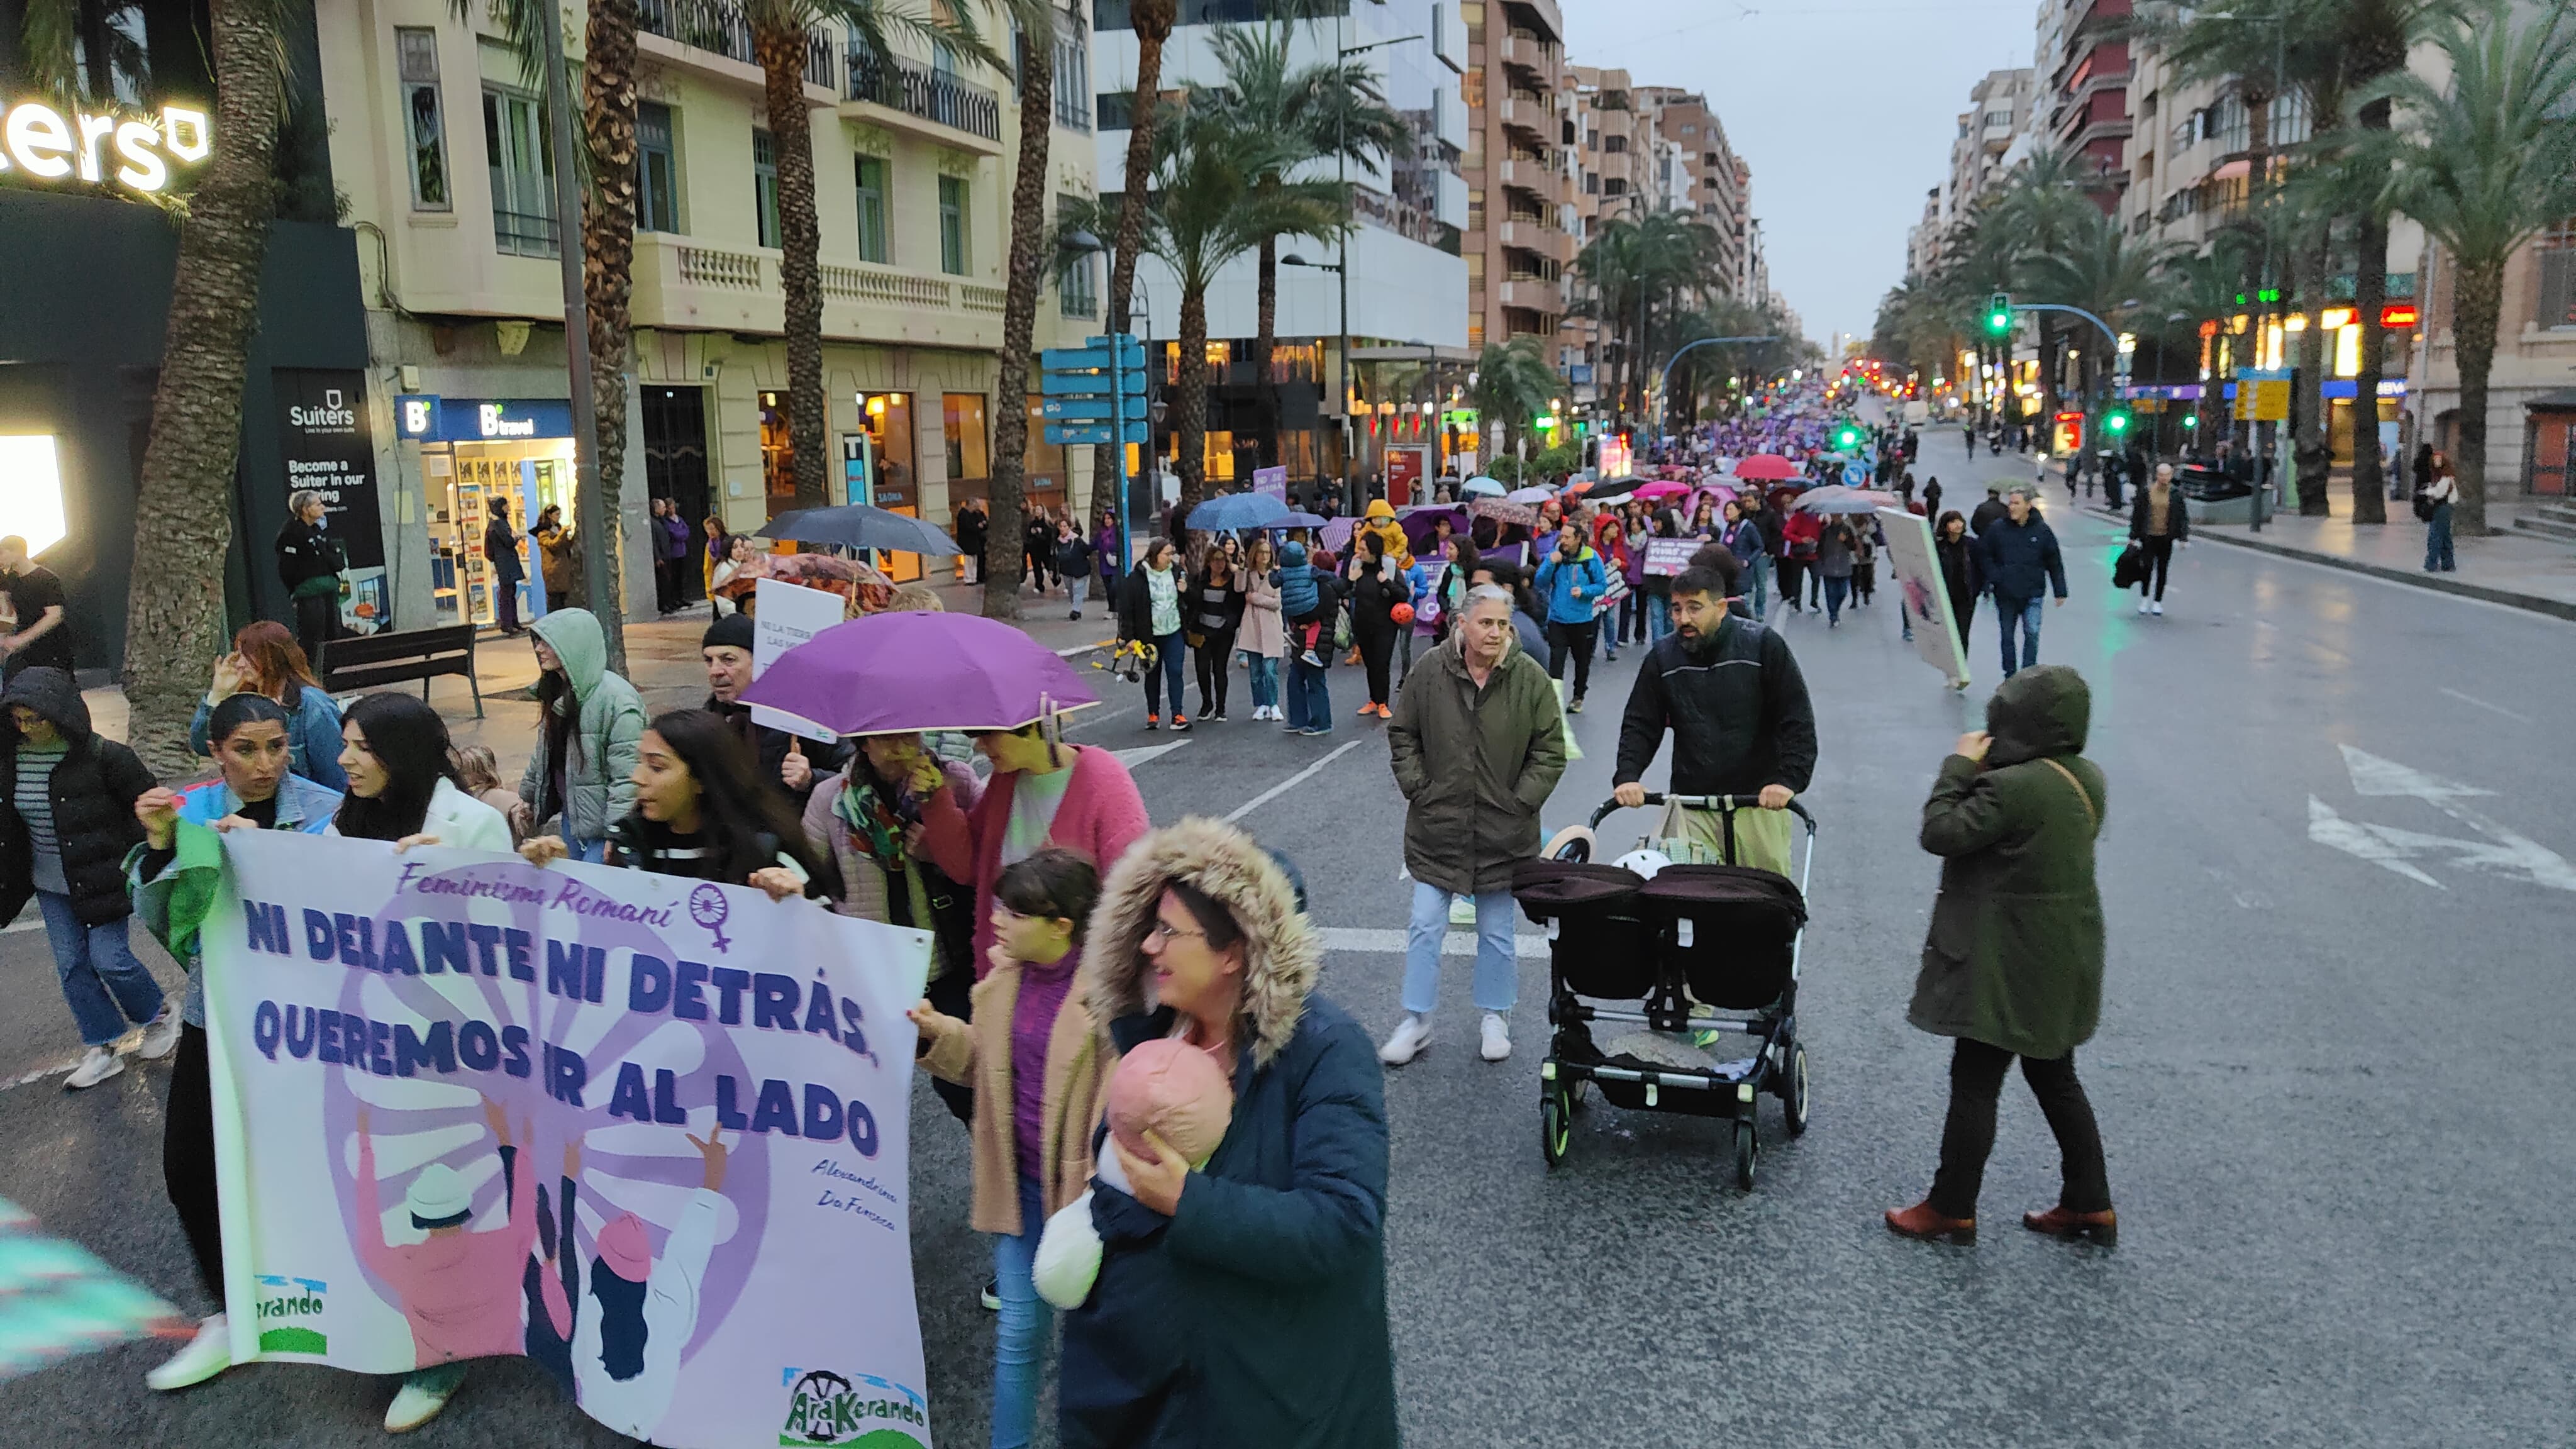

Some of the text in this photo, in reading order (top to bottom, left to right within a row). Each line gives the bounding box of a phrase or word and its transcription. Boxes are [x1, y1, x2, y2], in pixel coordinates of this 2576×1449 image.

[0, 103, 166, 191] ers
[291, 406, 355, 426] Suiters
[406, 402, 427, 432] B
[480, 404, 534, 436] B travel
[844, 436, 862, 458] T
[289, 460, 348, 474] Become a
[291, 474, 365, 488] Suiter in our
[772, 623, 784, 633] LA
[786, 626, 811, 640] TIERR
[550, 877, 680, 928] Romaní
[243, 899, 292, 956] NI
[303, 908, 536, 984] DELANTE
[547, 938, 607, 1004] NI
[253, 999, 880, 1160] QUEREMOS IR AL LADO
[784, 1391, 925, 1435] AraKerando
